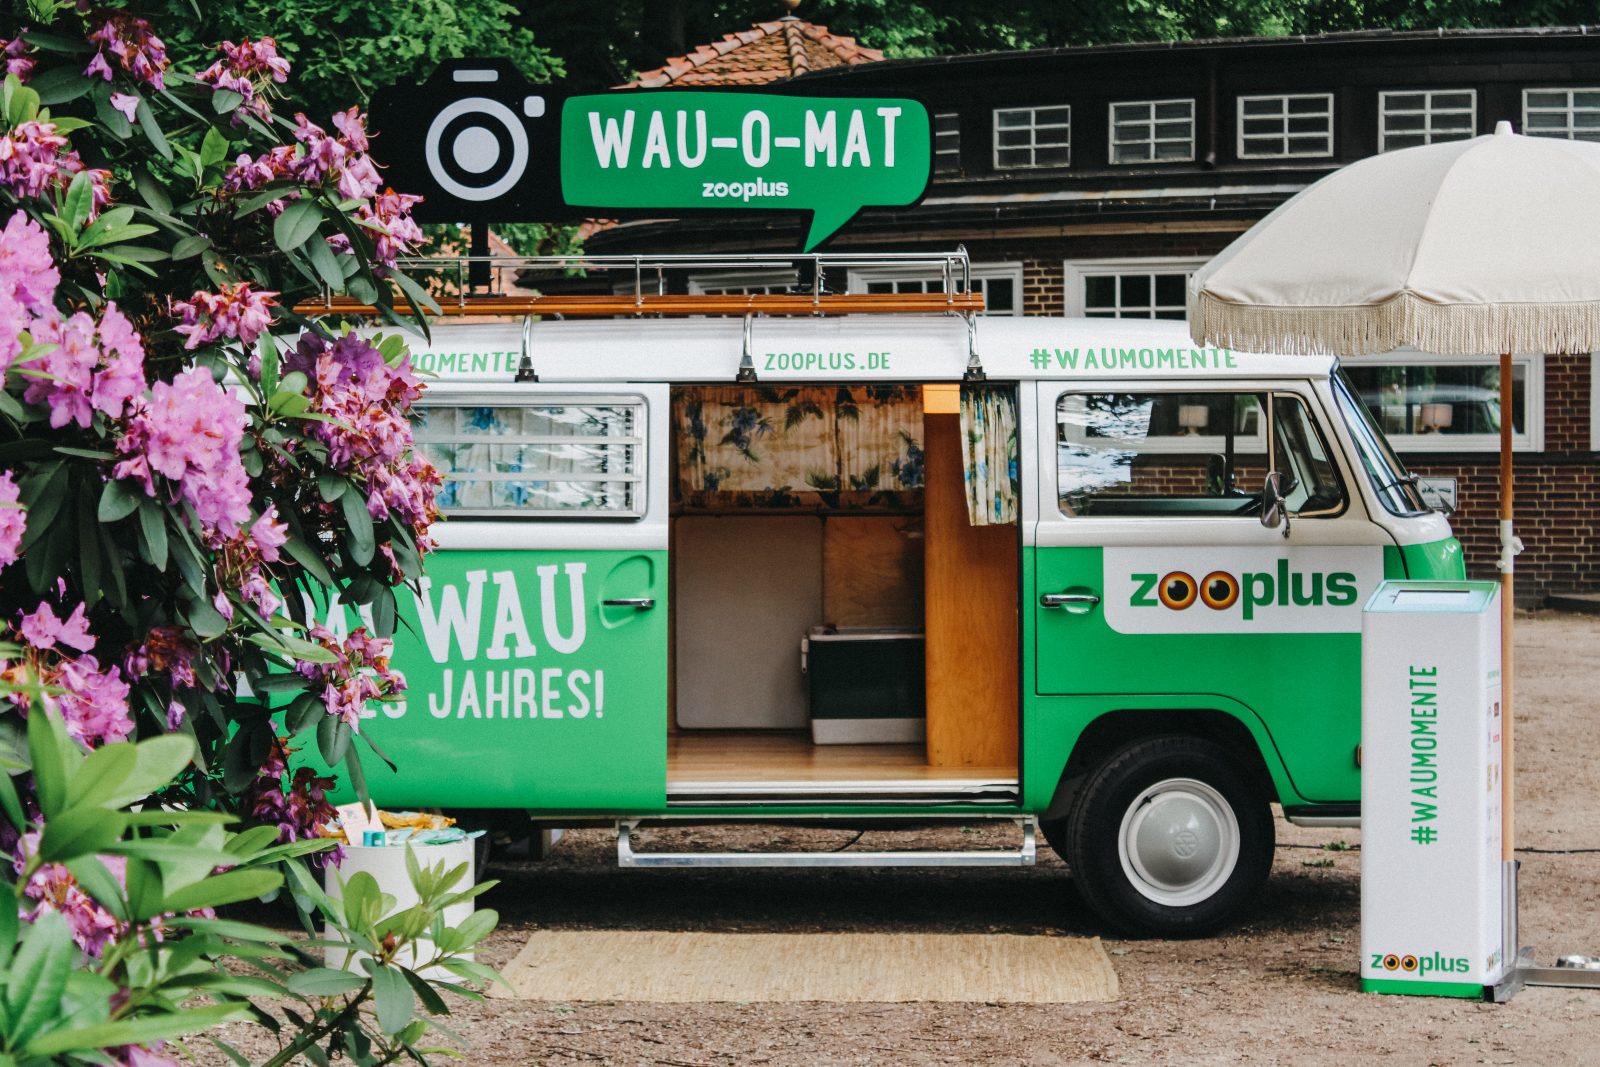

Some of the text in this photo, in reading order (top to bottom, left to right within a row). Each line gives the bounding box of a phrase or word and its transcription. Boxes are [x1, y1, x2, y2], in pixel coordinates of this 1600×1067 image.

[588, 107, 902, 169] WAU-O-MAT
[702, 177, 789, 202] zooplus
[765, 352, 891, 371] ZOOPLUS.DE
[1029, 347, 1238, 370] #WAUMOMENTE
[407, 562, 587, 664] WAU
[1130, 559, 1358, 620] zooplus
[428, 668, 604, 719] JAHRES!
[1409, 665, 1438, 845] #WAUMOMENTE
[1371, 951, 1470, 977] zooplus
